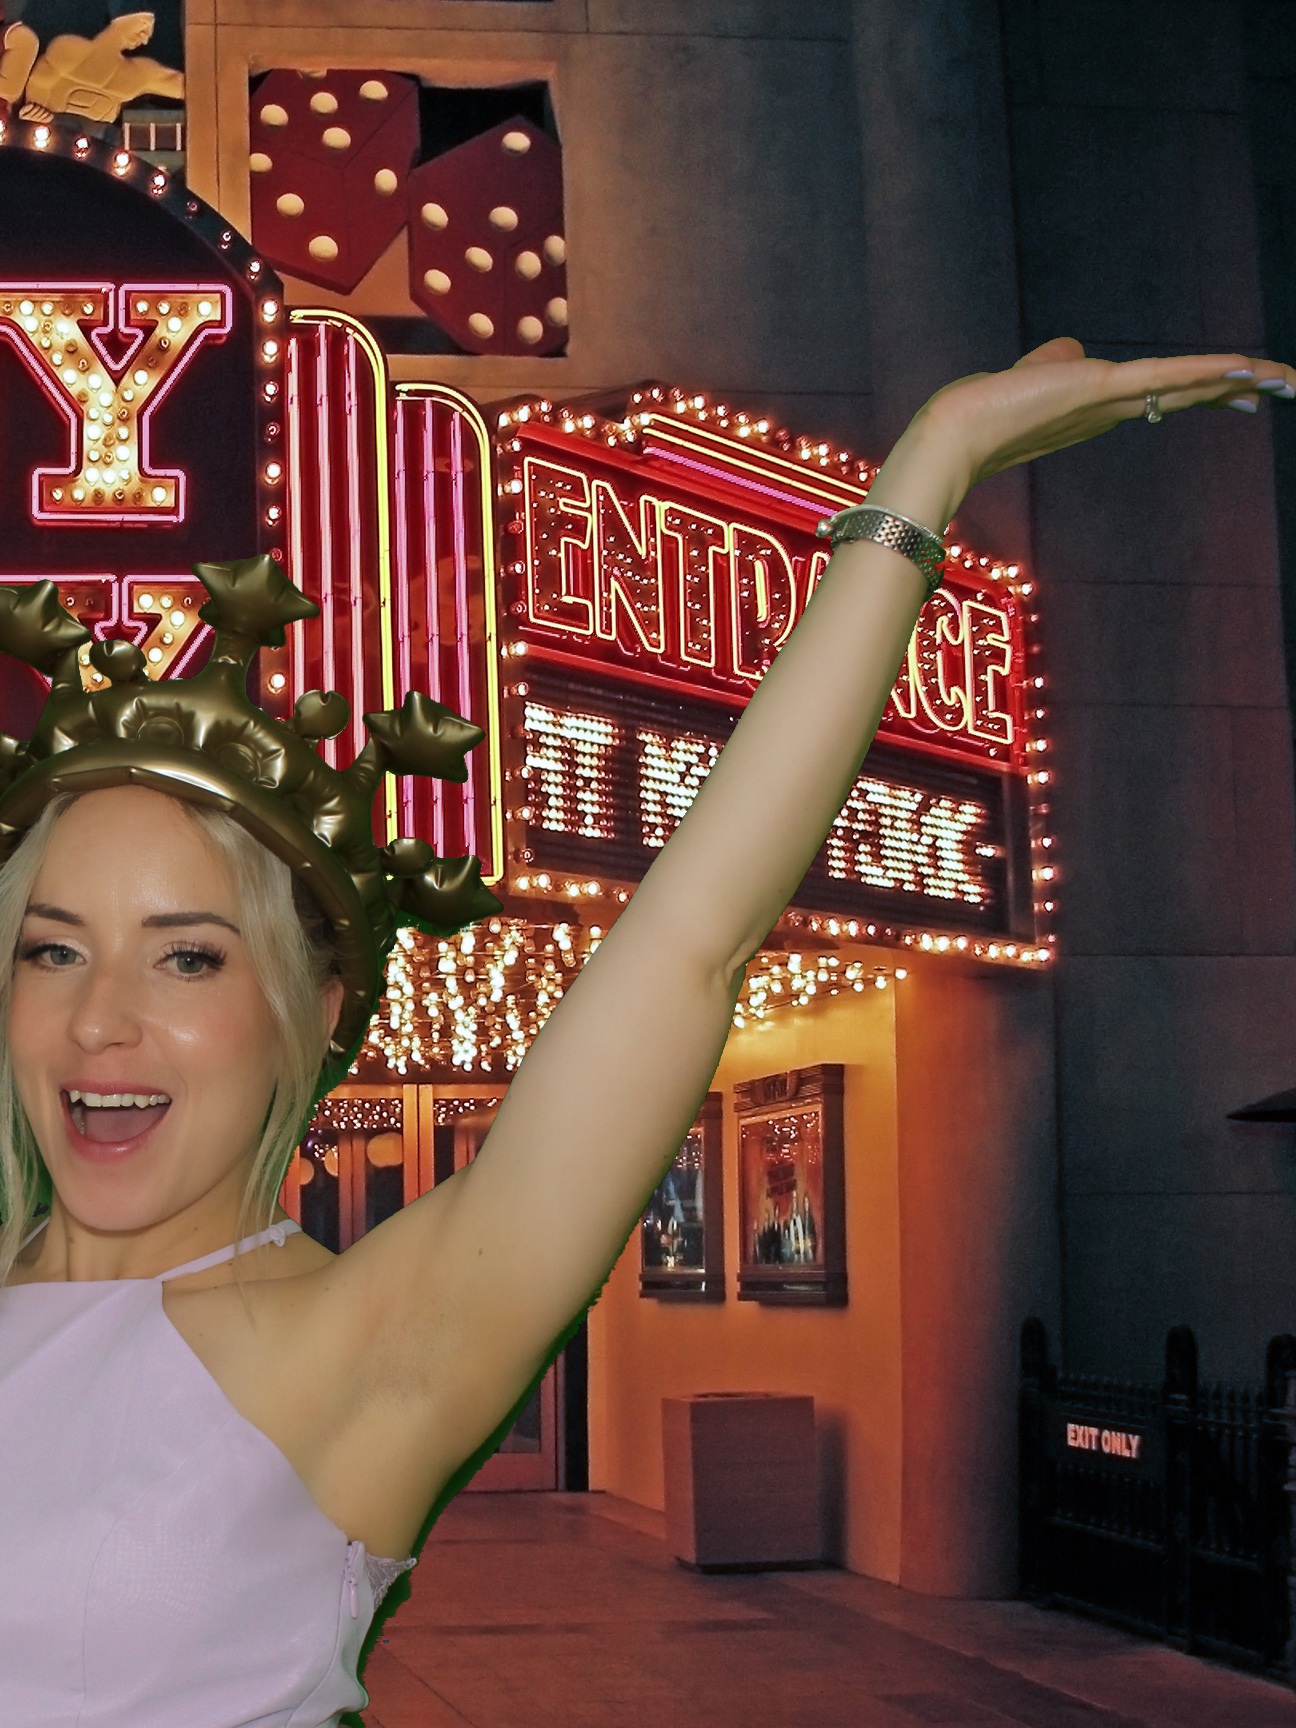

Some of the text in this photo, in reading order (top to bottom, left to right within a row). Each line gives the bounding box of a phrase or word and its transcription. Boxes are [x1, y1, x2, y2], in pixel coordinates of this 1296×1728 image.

[524, 457, 1014, 744] ENTRCE
[1067, 1422, 1141, 1458] EXIT ONLY
